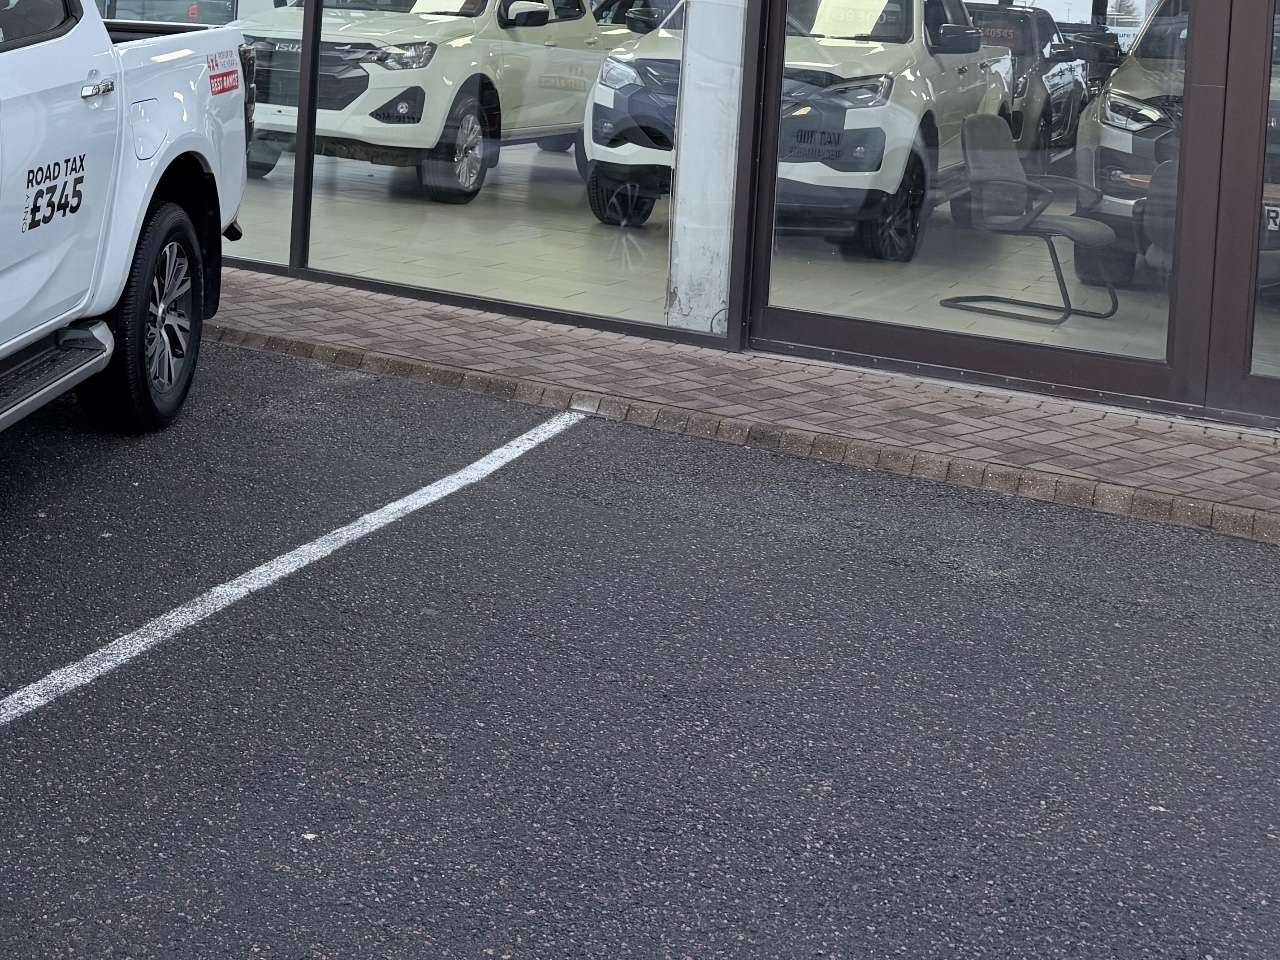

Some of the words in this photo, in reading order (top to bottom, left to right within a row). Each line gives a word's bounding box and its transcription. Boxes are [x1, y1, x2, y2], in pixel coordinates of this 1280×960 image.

[275, 43, 302, 52] ISU
[26, 161, 61, 189] ROAD
[64, 153, 86, 177] TAX
[21, 193, 30, 234] ONLY
[28, 175, 85, 231] £345
